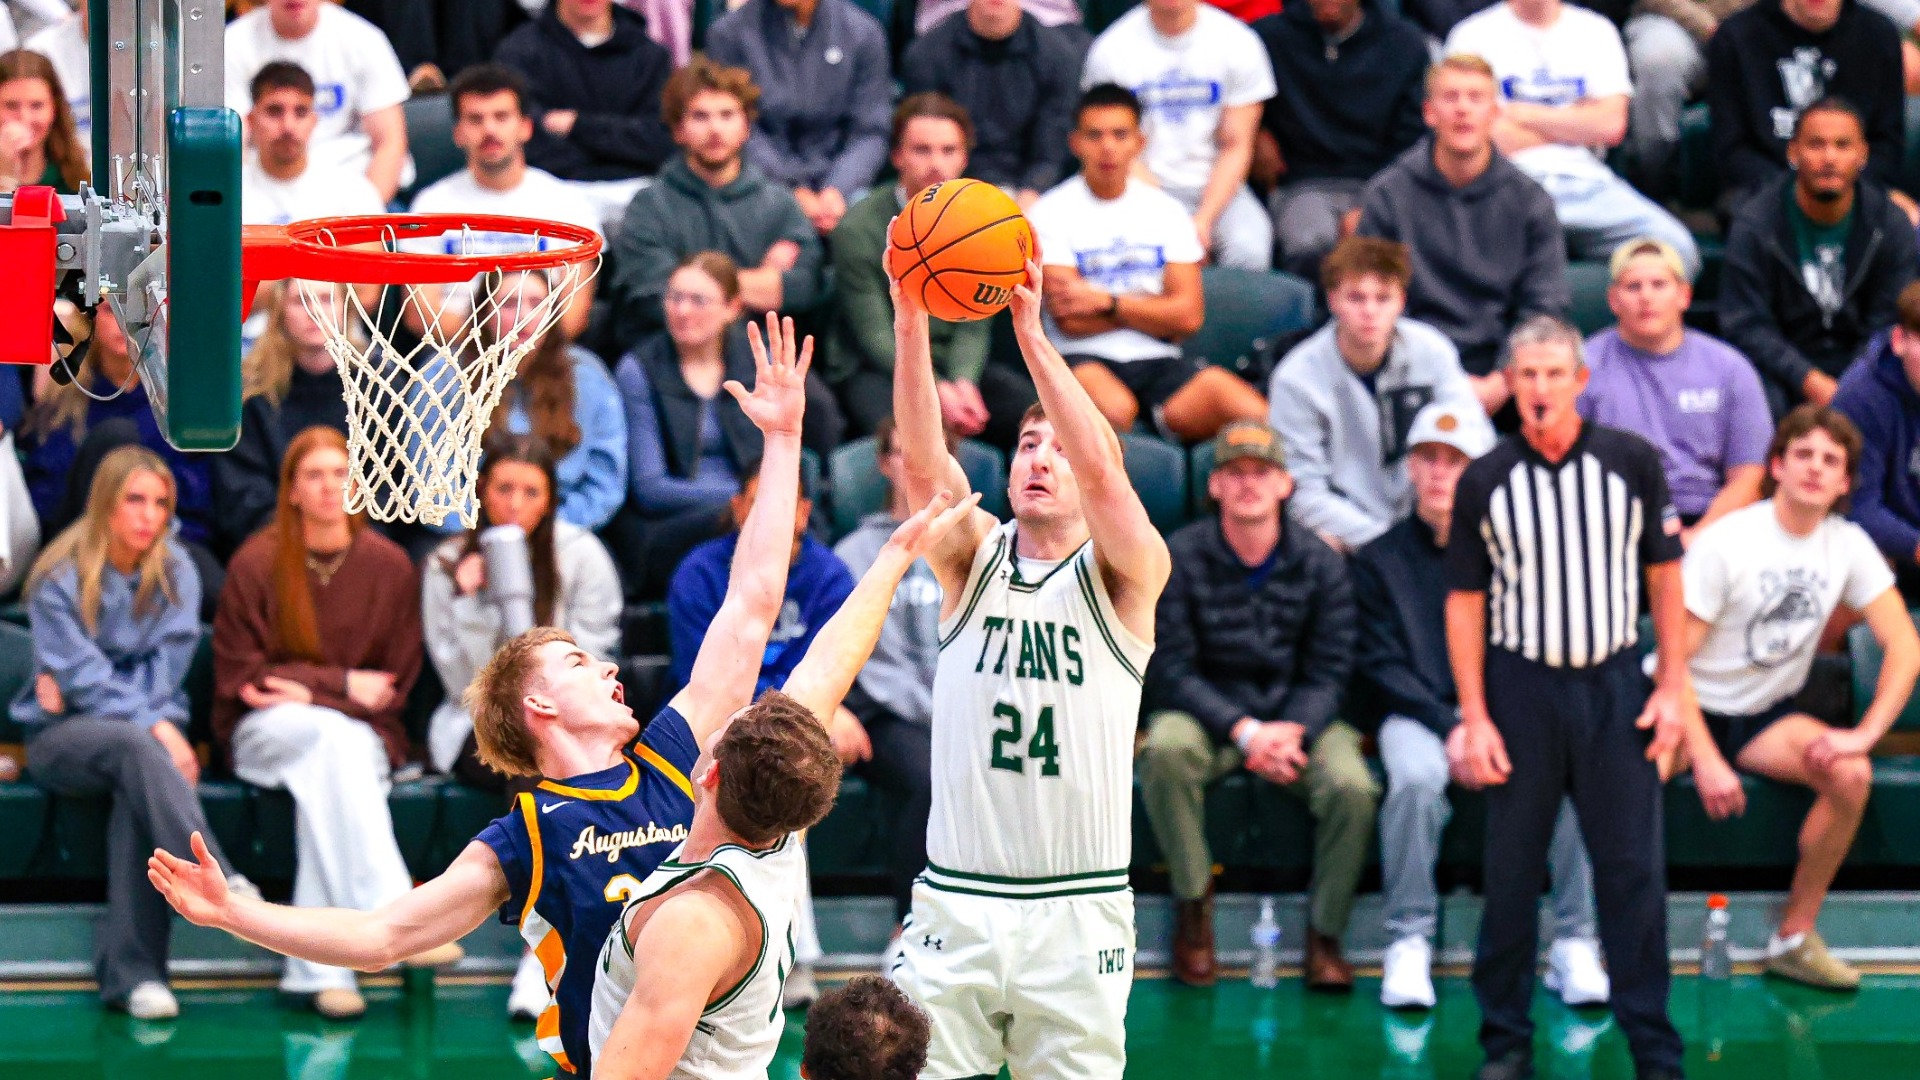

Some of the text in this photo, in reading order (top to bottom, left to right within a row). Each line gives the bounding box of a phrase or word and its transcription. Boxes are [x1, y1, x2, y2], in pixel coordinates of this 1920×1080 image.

[973, 282, 1013, 306] Wil
[975, 616, 1084, 687] TIANS
[990, 699, 1061, 778] 24
[1098, 947, 1125, 974] IWU
